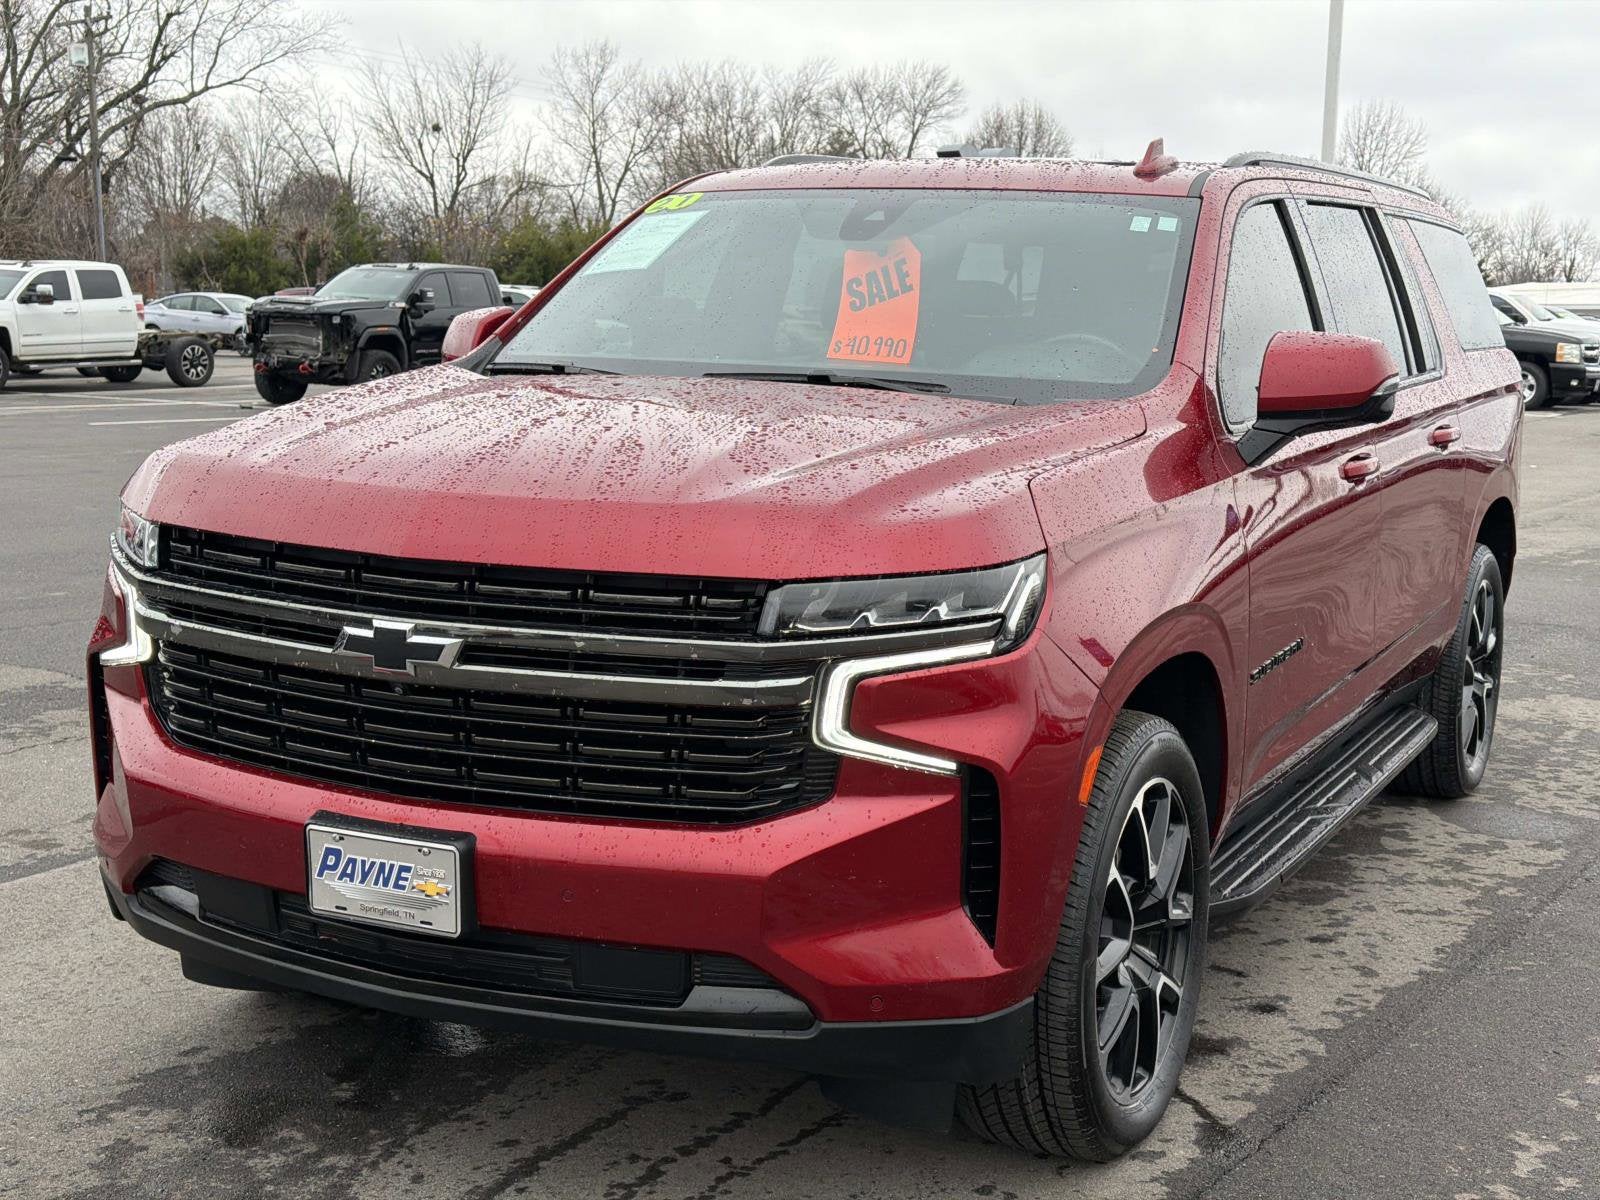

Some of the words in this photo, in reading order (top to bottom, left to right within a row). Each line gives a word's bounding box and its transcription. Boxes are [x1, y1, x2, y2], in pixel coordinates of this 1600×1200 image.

[847, 258, 914, 313] SALE
[1249, 636, 1304, 686] SUBURBAN
[316, 844, 414, 894] PAYNE
[359, 903, 401, 919] Springfield,
[403, 910, 415, 920] TN
